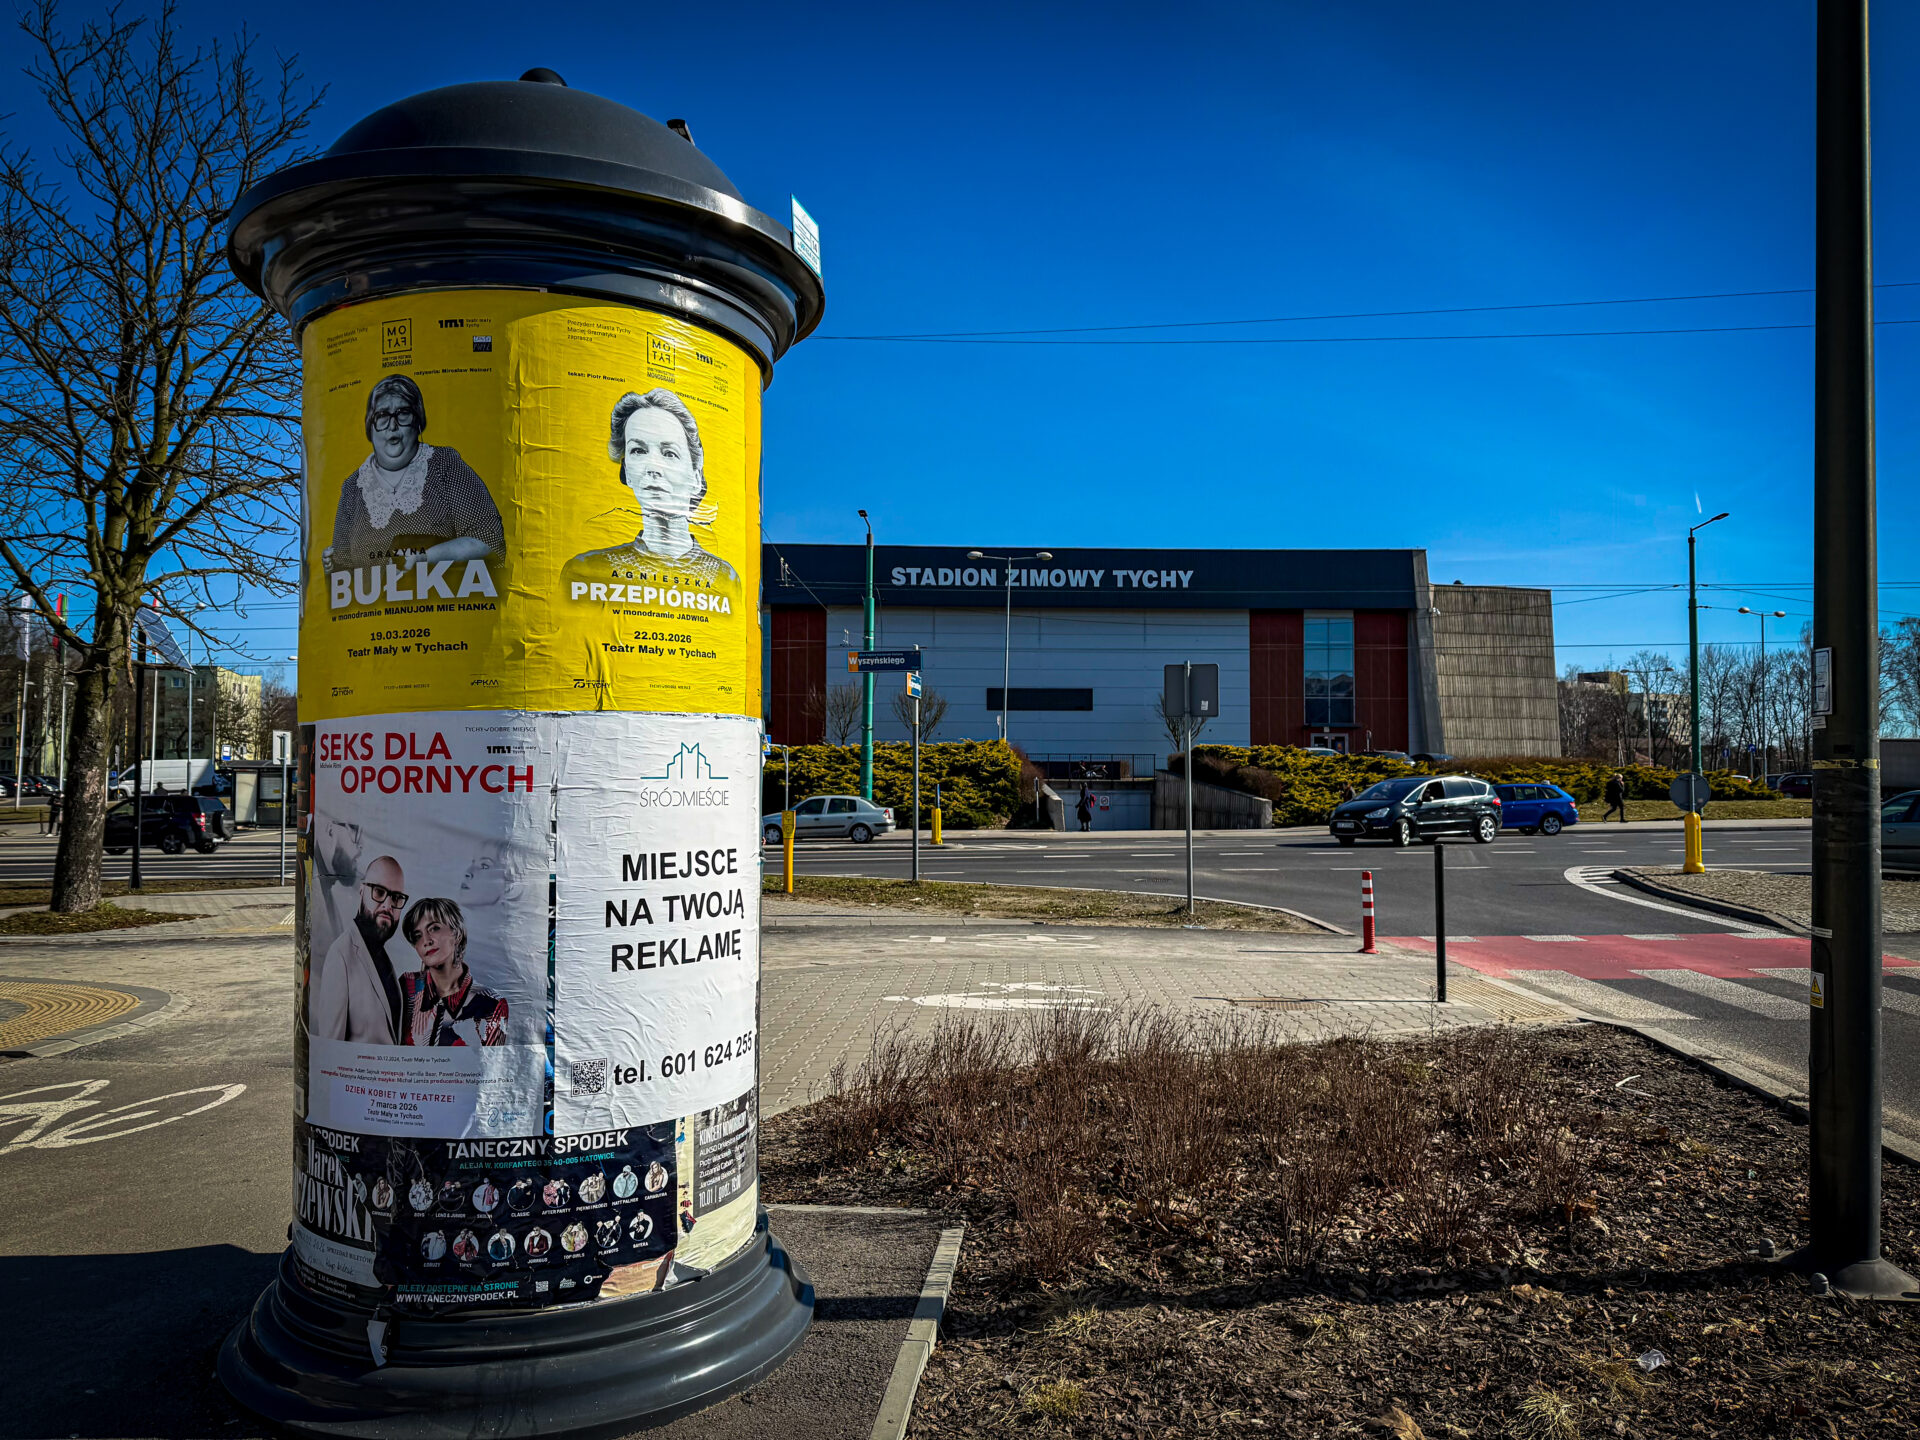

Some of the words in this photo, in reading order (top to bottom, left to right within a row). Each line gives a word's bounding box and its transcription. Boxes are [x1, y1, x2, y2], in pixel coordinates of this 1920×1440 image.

[369, 547, 427, 560] GRAŻYNA
[330, 559, 498, 610] BUŁKA
[611, 570, 712, 588] AGNIESZKA
[891, 566, 997, 587] STADION
[1005, 567, 1105, 588] ZIMOWY
[1112, 569, 1194, 589] TYCHY
[571, 581, 731, 614] PRZEPIÓRSKA
[338, 608, 382, 622] monodramie
[384, 605, 434, 616] MIANUJOM
[436, 604, 455, 612] MIE
[458, 603, 497, 611] HANKA
[623, 608, 675, 620] monodramie
[676, 613, 709, 623] JADWIGA
[370, 628, 431, 641] 19.03.2026
[634, 631, 692, 643] 22.03.2026
[347, 648, 371, 658] Teatr
[373, 644, 399, 656] Mały
[402, 645, 411, 653] w
[414, 641, 468, 653] Tychach
[601, 643, 635, 653] Teatr
[638, 645, 665, 656] Mały
[679, 647, 717, 659] Tychach
[848, 656, 905, 666] Wyszyńskiego
[320, 732, 374, 761] SEKS
[385, 732, 452, 760] DLA
[340, 765, 534, 794] OPORNYCH
[639, 787, 729, 807] ŚRÓDMIEŚCIE
[622, 848, 738, 882] MIEJSCE
[605, 898, 654, 928] NA
[662, 888, 745, 923] TWOJĄ
[611, 929, 742, 973] REKLAMĘ
[614, 1060, 652, 1086] tel.
[661, 1049, 696, 1078] 601
[704, 1040, 732, 1068] 624
[736, 1031, 752, 1058] 255
[345, 1084, 366, 1096] DZIEŃ
[368, 1087, 397, 1099] KOBIET
[400, 1091, 407, 1100] W
[410, 1092, 456, 1103] TEATRZE!
[367, 1108, 379, 1116] Teatr
[379, 1110, 393, 1119] Mały
[400, 1112, 423, 1120] Tychach
[370, 1099, 375, 1107] 7
[376, 1101, 397, 1110] marca
[399, 1102, 418, 1112] 2026
[446, 1138, 549, 1159] TANECZNY
[554, 1130, 629, 1154] SPODEK
[460, 1162, 483, 1170] ALEJA
[494, 1160, 542, 1169] KORFANTEGO
[553, 1156, 579, 1166] 40-005
[579, 1152, 615, 1163] KATOWICE
[397, 1284, 427, 1293] BILETY
[470, 1284, 482, 1292] NA
[483, 1281, 520, 1291] STRONIE
[396, 1290, 519, 1303] WWW.TANECZNYSPODEK.PL
